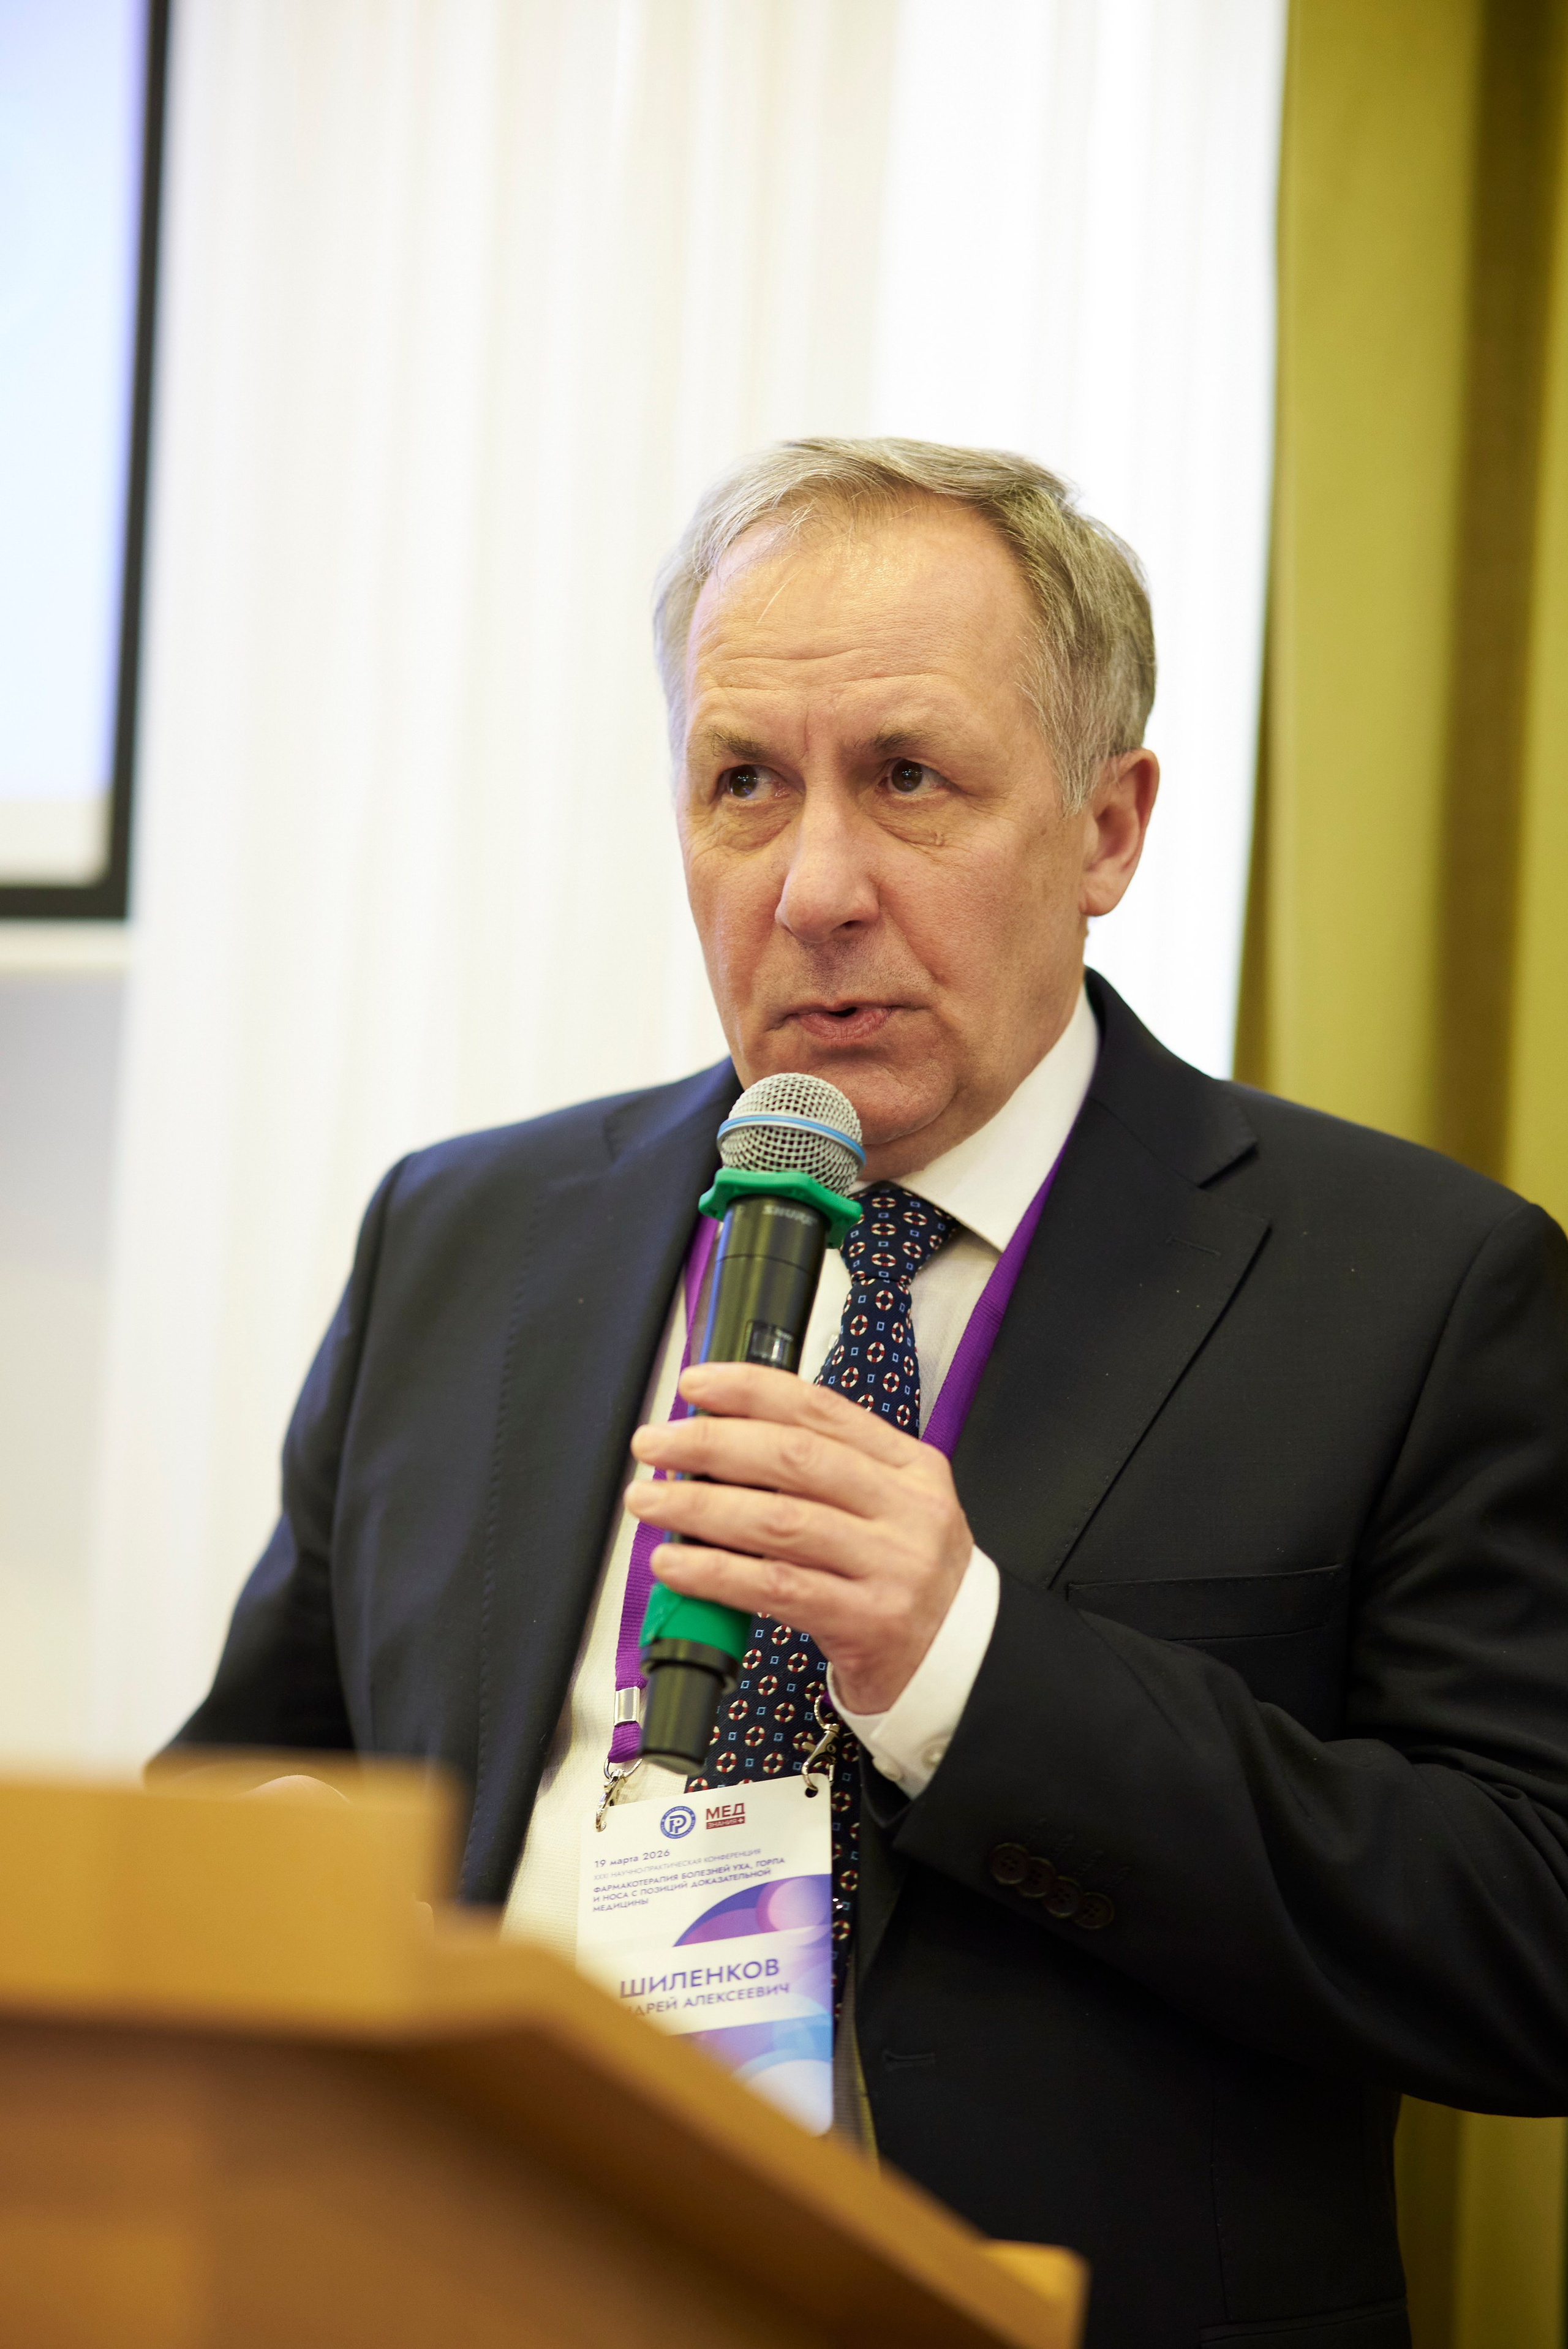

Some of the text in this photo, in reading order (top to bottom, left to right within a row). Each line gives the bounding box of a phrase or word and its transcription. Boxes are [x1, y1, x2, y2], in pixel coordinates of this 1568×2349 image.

[706, 1803, 745, 1820] МЕД
[610, 1857, 638, 1865] марта
[643, 1849, 670, 1860] 2026
[704, 1849, 761, 1863] КОНФЕРЕНЦИЯ
[594, 1858, 785, 1893] ФАРМАКОТЕРАПИЯ БОЛЕЗНЕЙ УХА, ГОРЛА
[603, 1892, 628, 1901] НОСА
[641, 1880, 688, 1895] ПОЗИЦИЙ
[691, 1868, 771, 1888] ДОКАЗАТЕЛЬНОЙ
[593, 1898, 649, 1912] МЕДИЦИНЫ
[620, 1958, 779, 1999] ШИЛЕНКОВ
[628, 1982, 790, 2016] ДРЕЙ АЛЕКСЕЕВИЧ
